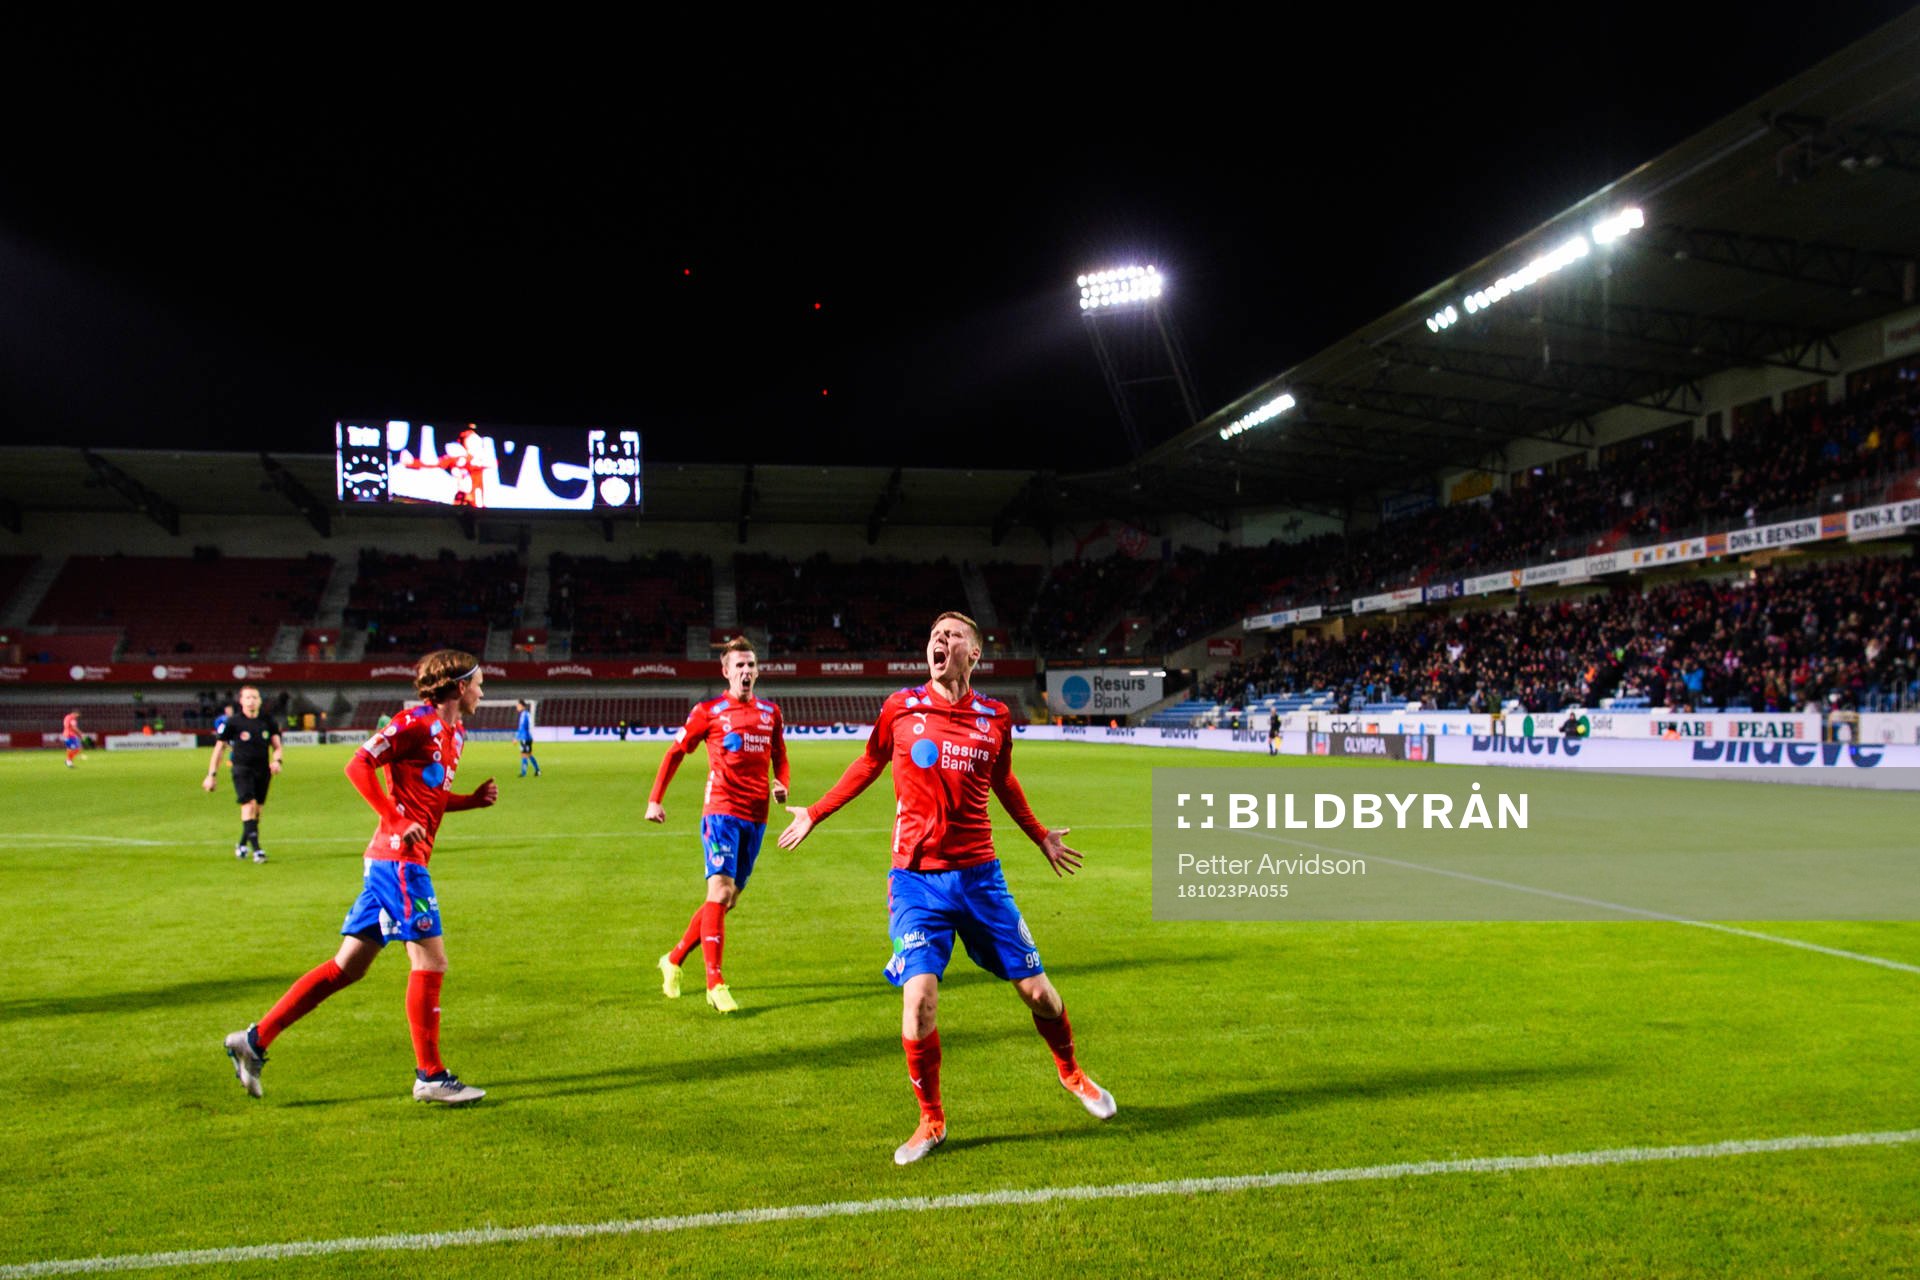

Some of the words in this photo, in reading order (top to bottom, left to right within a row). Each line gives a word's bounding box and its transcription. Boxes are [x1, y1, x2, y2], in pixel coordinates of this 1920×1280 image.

[1731, 532, 1763, 549] DIN-X
[1766, 522, 1816, 543] BENSIN
[1093, 676, 1145, 691] Resurs
[1093, 693, 1131, 708] Bank
[1737, 721, 1795, 739] PEAB
[942, 741, 990, 761] Resurs
[1344, 737, 1386, 754] OLYMPIA
[941, 755, 975, 772] Bank
[1025, 951, 1040, 969] 99
